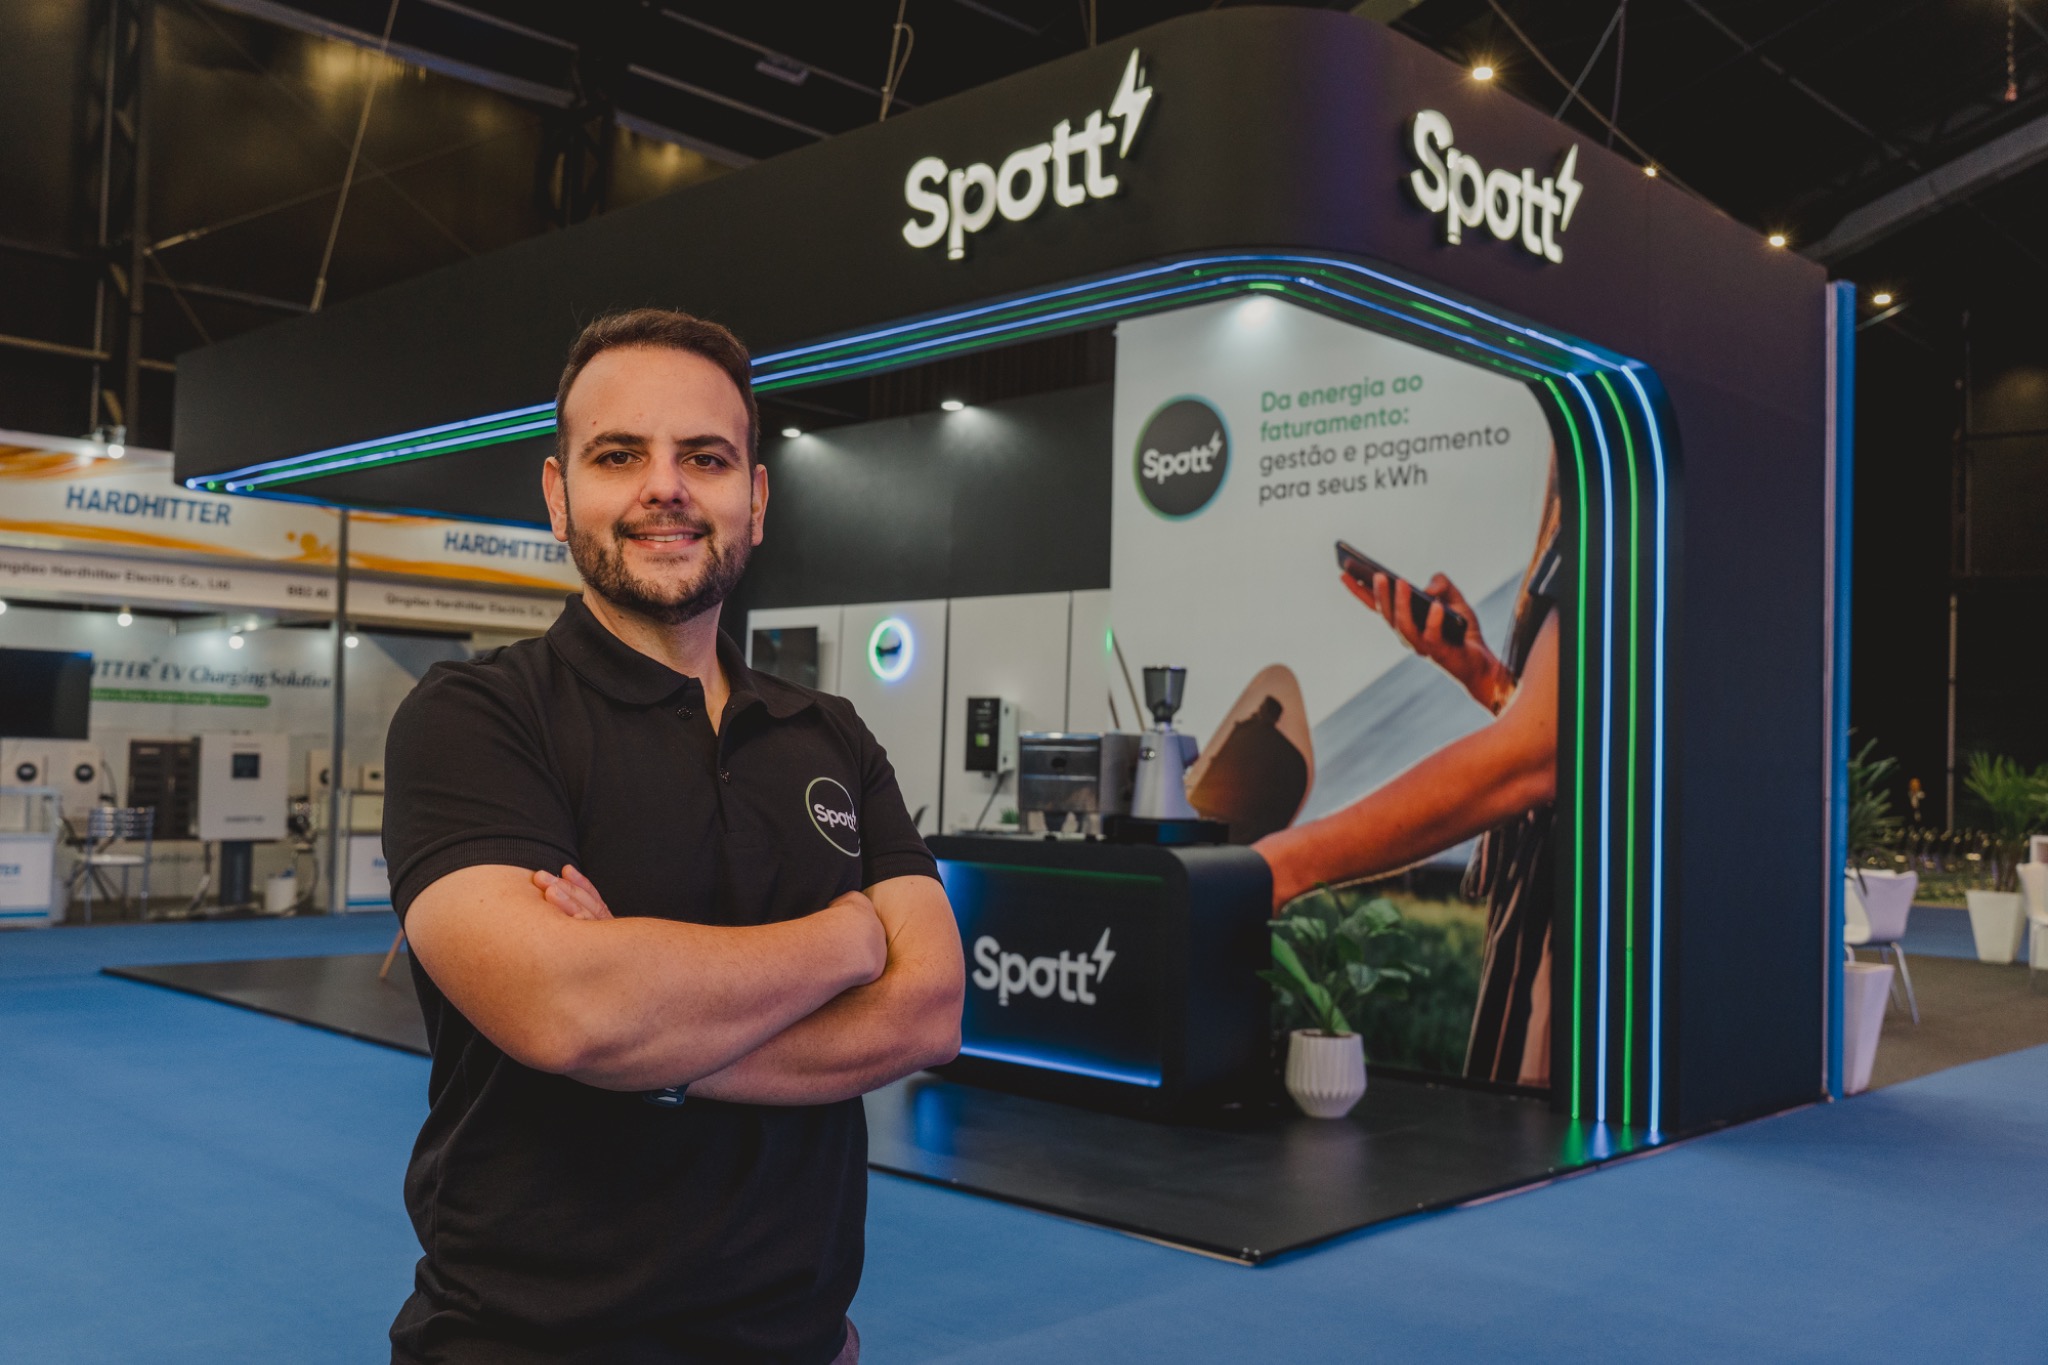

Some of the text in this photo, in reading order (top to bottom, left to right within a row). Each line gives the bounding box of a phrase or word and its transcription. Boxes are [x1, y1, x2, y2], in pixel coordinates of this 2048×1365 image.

[902, 110, 1119, 260] Spott
[1409, 109, 1563, 263] Spott
[1261, 374, 1424, 413] Da energia ao
[1260, 406, 1411, 443] faturamento:
[1142, 448, 1213, 484] Spott
[1259, 424, 1511, 477] gestão e pagamento
[1258, 464, 1428, 507] para seus kWh
[65, 486, 232, 526] HARDHITTER
[444, 531, 568, 564] HARDHITTER
[188, 666, 267, 691] Charging
[813, 803, 857, 832] Spott
[971, 934, 1096, 1005] Spott
